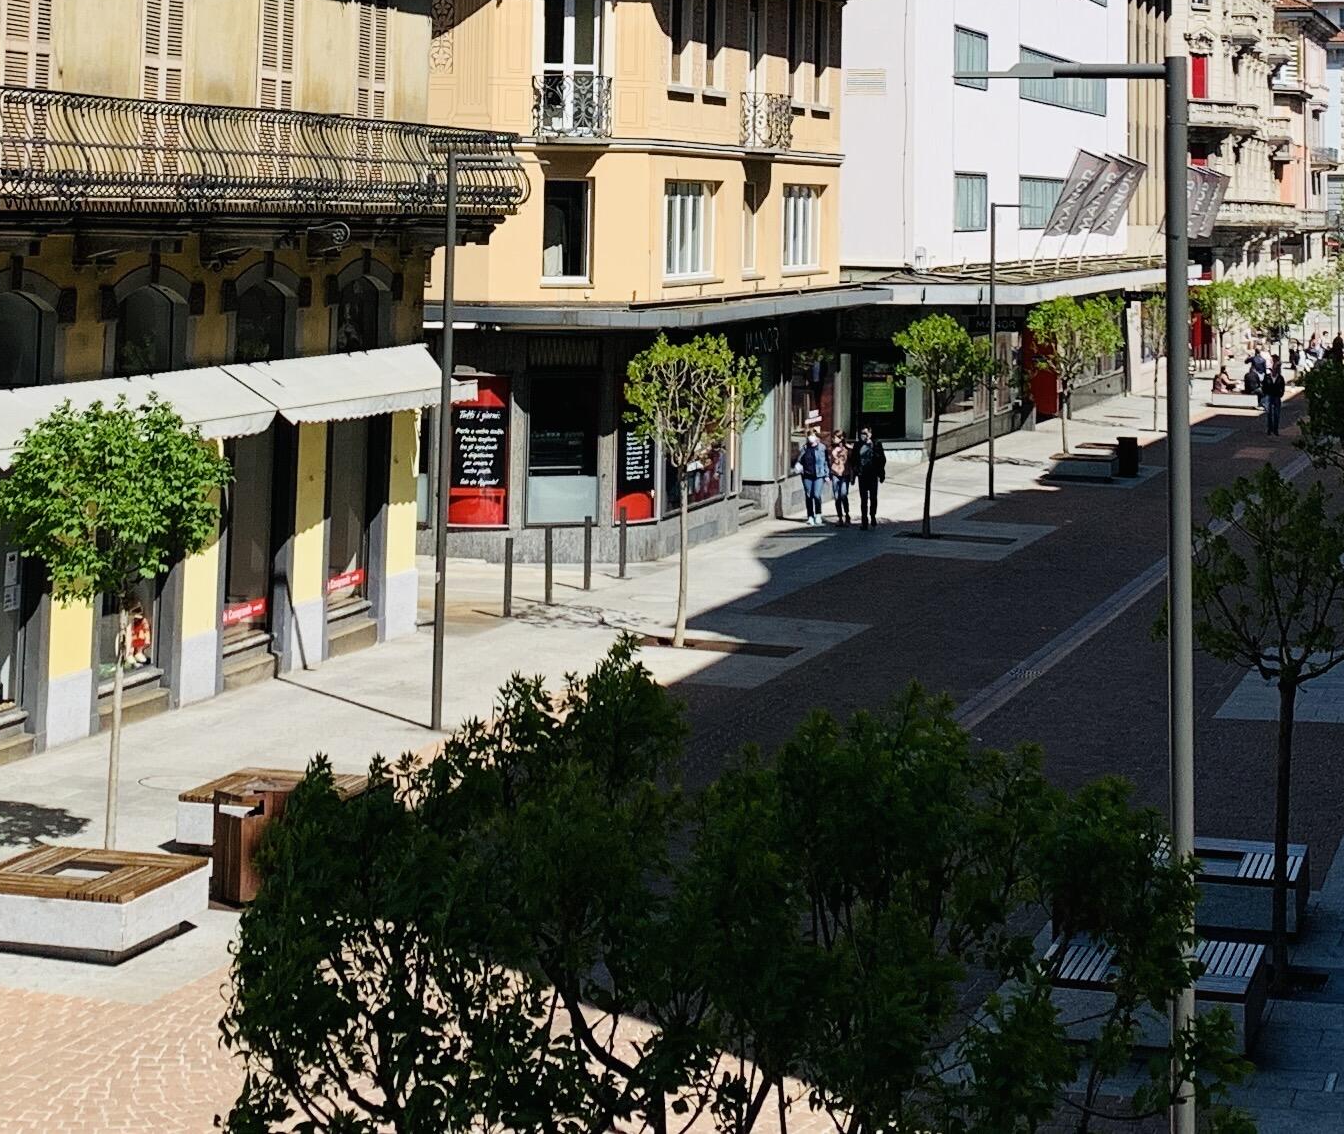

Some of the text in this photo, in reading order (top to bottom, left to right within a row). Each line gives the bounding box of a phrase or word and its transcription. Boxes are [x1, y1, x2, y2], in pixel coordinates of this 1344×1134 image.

[1054, 169, 1096, 232] MANOR
[1078, 171, 1118, 231] MANOR
[745, 327, 780, 354] MANOR
